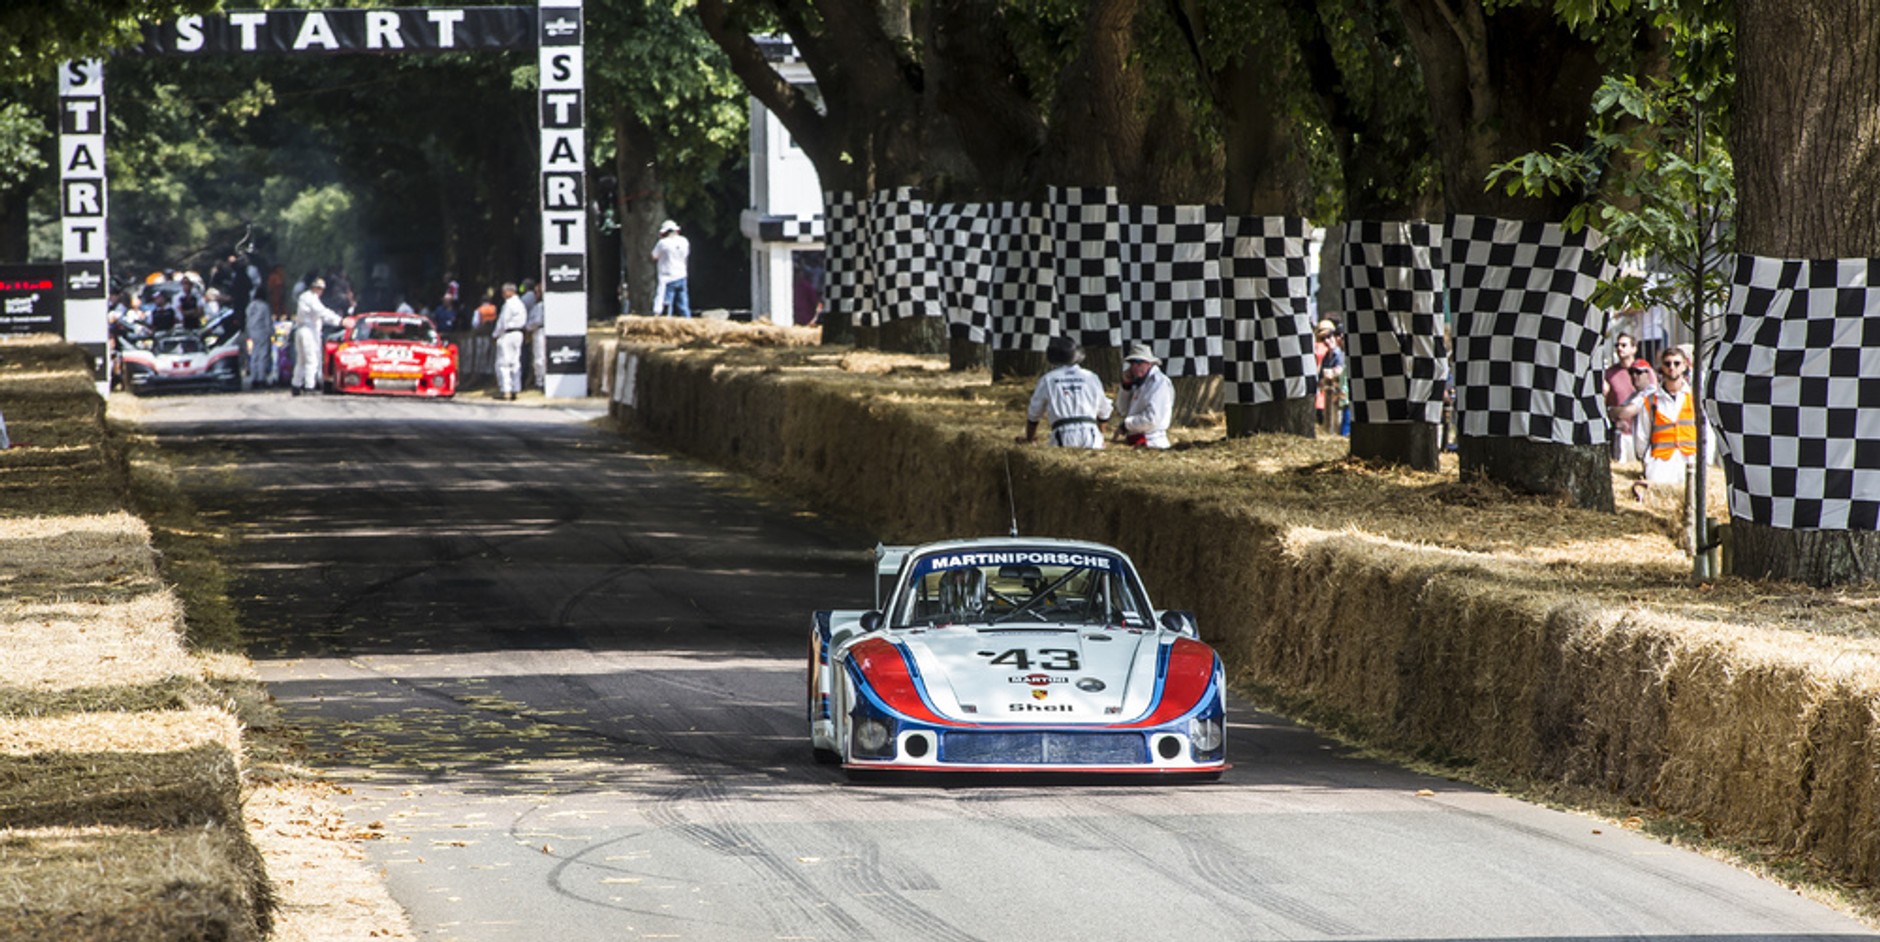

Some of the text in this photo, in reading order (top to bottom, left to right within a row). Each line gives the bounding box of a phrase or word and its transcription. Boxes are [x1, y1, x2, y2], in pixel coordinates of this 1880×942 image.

[176, 9, 464, 51] START
[66, 59, 99, 253] START
[547, 54, 578, 246] START
[990, 648, 1081, 671] 43
[1009, 676, 1067, 684] MARTINI
[1009, 703, 1073, 712] Shell
